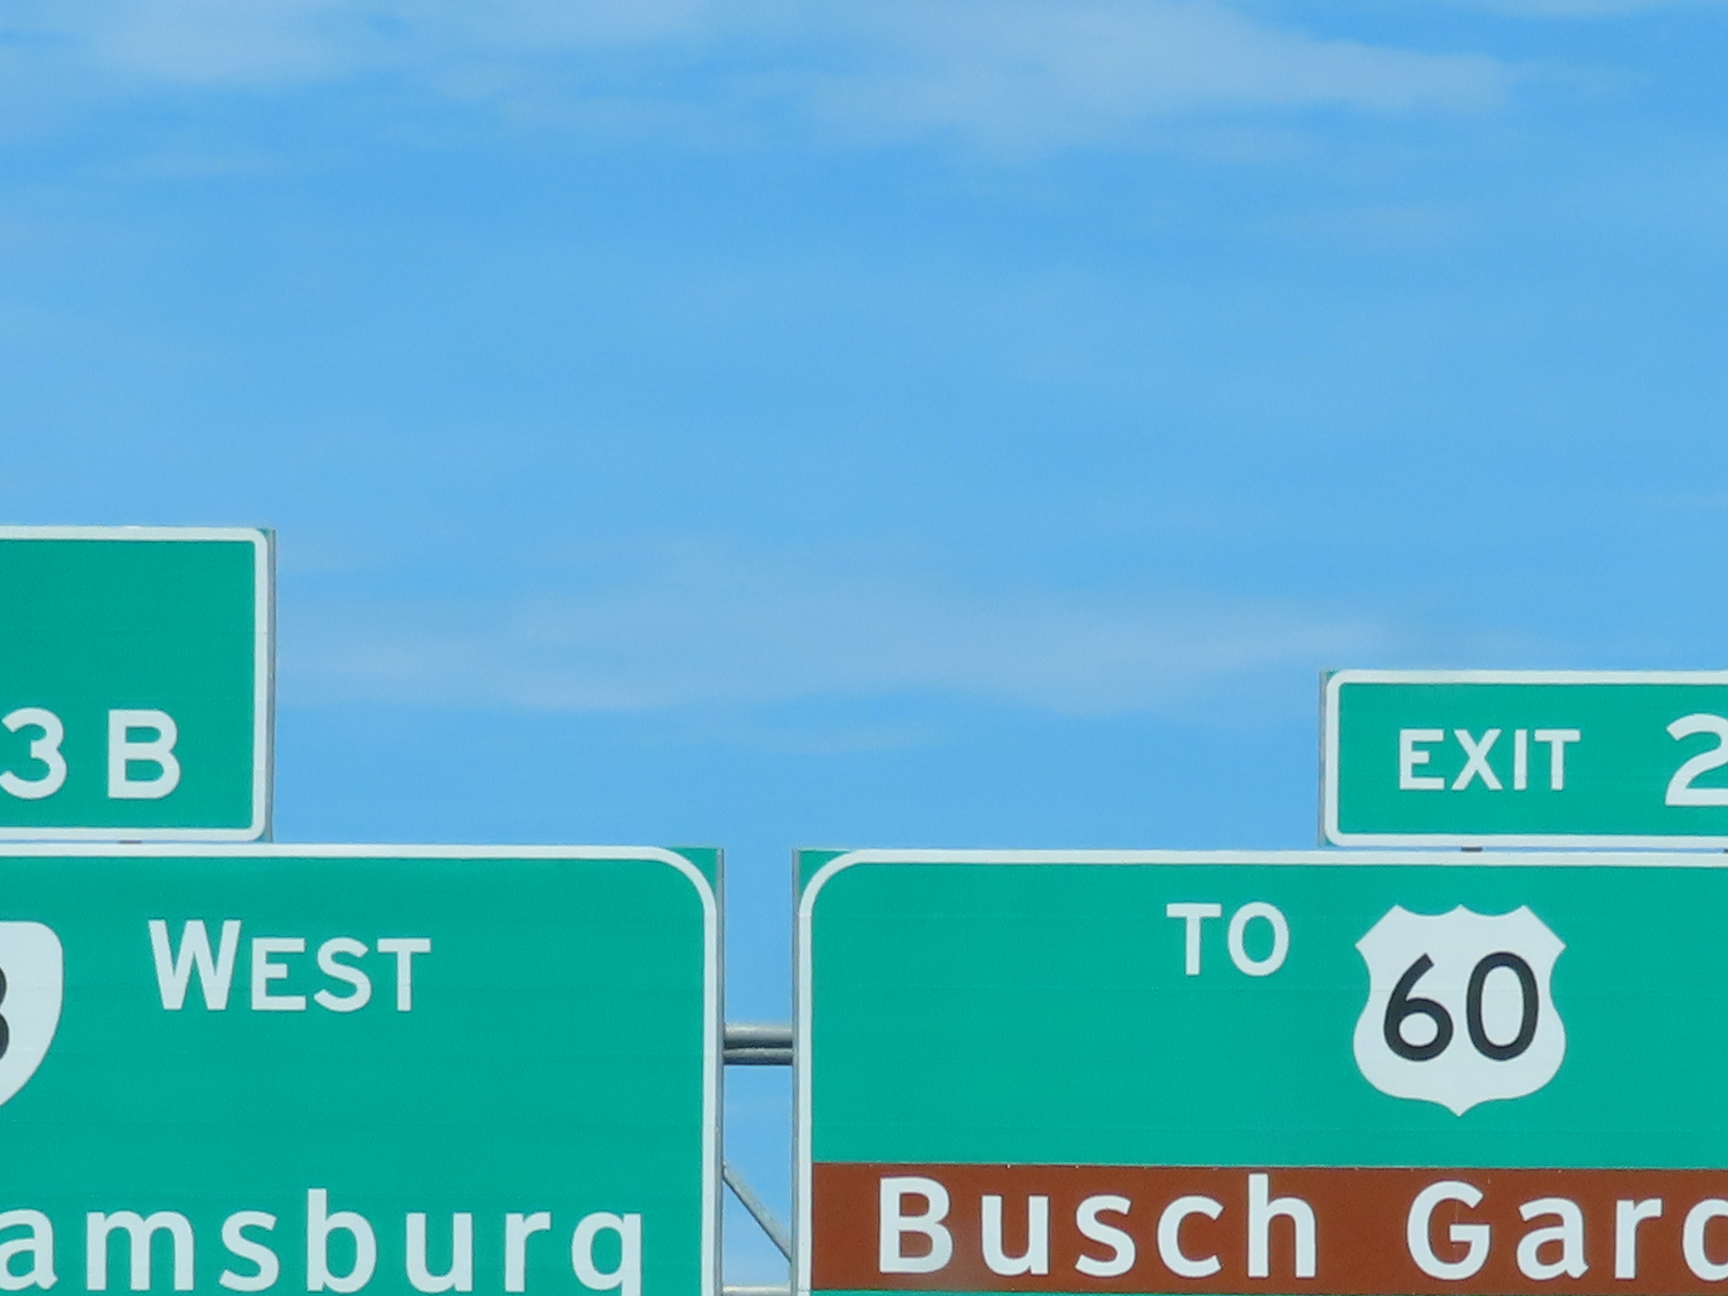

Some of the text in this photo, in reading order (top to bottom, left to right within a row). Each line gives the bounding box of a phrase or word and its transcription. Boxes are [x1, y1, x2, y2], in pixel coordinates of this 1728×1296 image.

[108, 708, 182, 800] B
[1398, 727, 1580, 791] EXIT
[149, 918, 432, 1014] WEST
[1166, 901, 1291, 977] TO
[1381, 950, 1540, 1063] 60
[877, 1174, 1318, 1281] Busch
